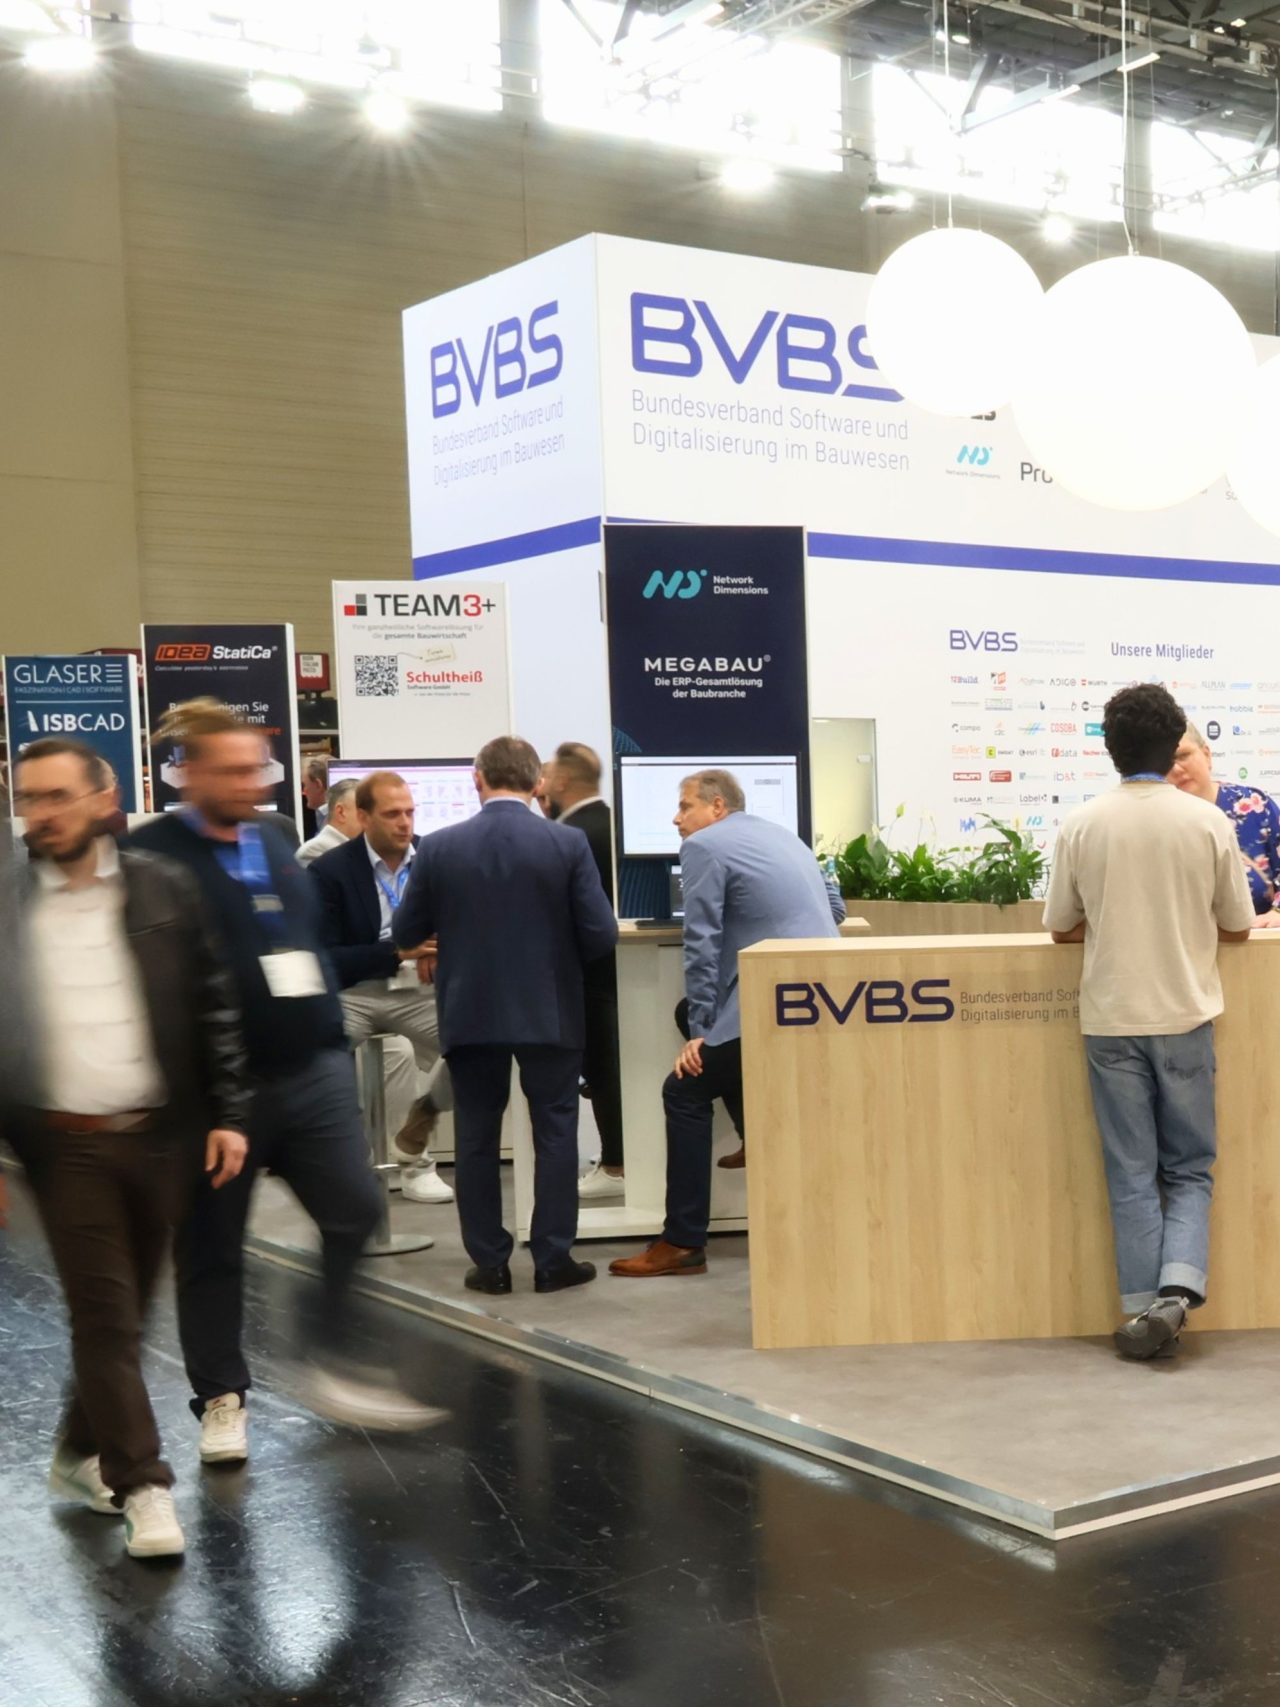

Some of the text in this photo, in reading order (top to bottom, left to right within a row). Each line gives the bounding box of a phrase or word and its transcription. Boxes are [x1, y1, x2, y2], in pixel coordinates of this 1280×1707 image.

[430, 300, 563, 419] BVBS
[631, 389, 909, 441] Bundesverband Software und
[432, 395, 564, 455] Bundesverband Software und
[632, 422, 910, 471] Digitalisierung im Bauwesen
[433, 433, 565, 488] Digitalisierung im Bauwesen
[713, 576, 754, 584] Network
[713, 586, 769, 595] Dimensions
[384, 632, 415, 641] gesamte
[416, 632, 467, 640] Bauwirtschaft
[950, 630, 1018, 652] BVBS
[1111, 642, 1215, 661] Unsere Mitglieder
[13, 664, 102, 684] GLASER
[406, 670, 483, 683] Schultheiß
[654, 676, 763, 688] Die ERP-Gesamtlösung
[672, 688, 746, 698] der Baubranche
[252, 701, 269, 712] Sie
[43, 713, 126, 732] ISBCAD
[247, 714, 266, 724] mit
[775, 979, 955, 1027] BVBS
[960, 989, 1054, 1005] Bundesverband
[960, 1006, 1069, 1024] Digitalisierung im
